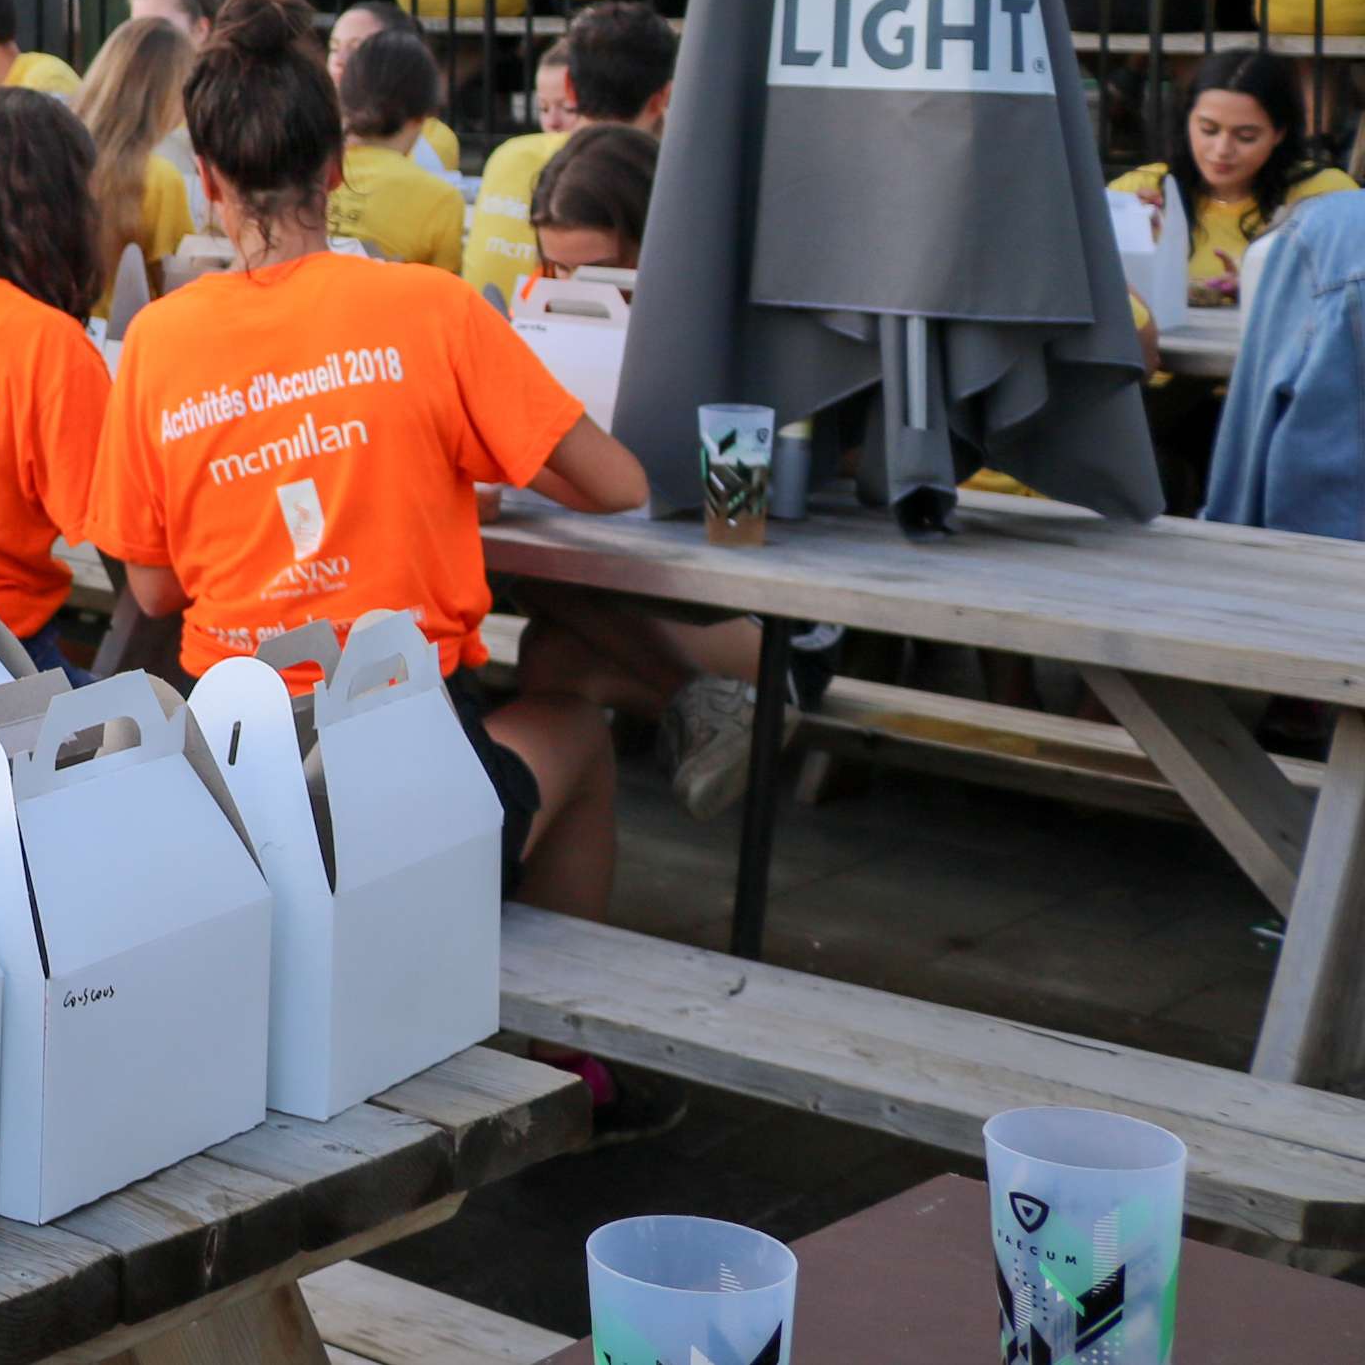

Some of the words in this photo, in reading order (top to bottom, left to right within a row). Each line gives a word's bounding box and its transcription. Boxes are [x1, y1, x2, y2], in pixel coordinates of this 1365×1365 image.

[161, 385, 247, 444] Activités
[248, 352, 346, 413] d'Accueil
[345, 347, 404, 383] 2018
[209, 412, 369, 486] mcmillan
